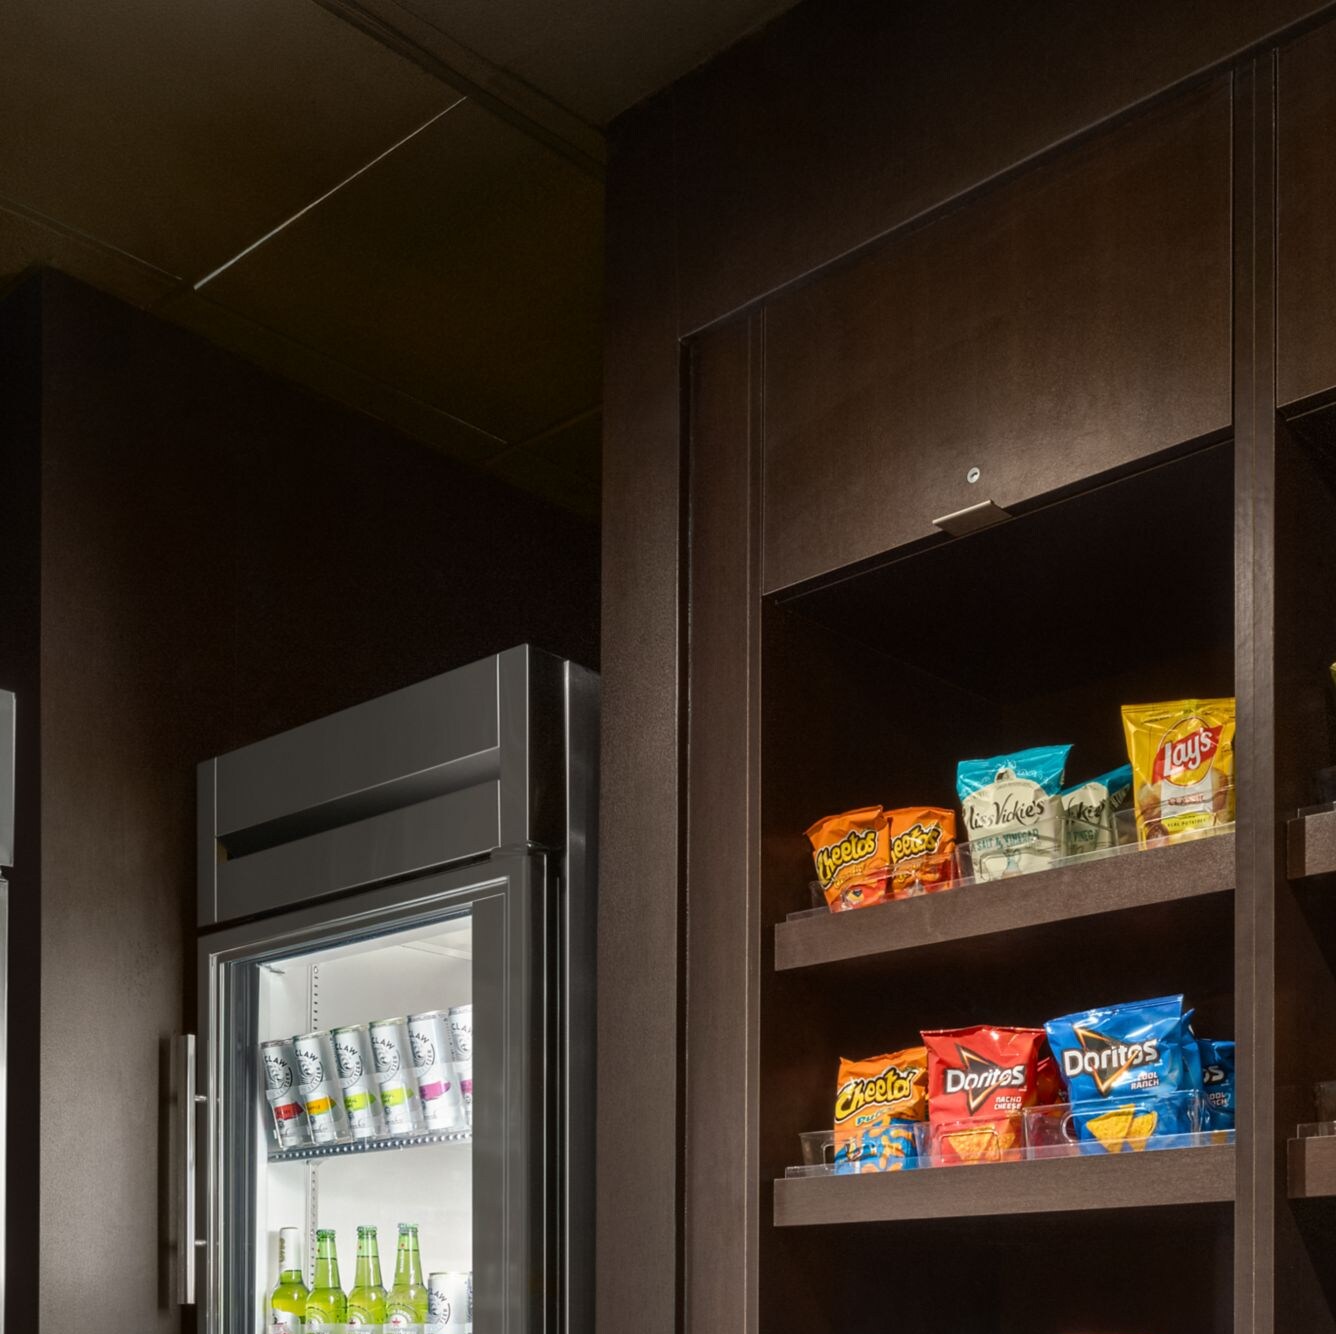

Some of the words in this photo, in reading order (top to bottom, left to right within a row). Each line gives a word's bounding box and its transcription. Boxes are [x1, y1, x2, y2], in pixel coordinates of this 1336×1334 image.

[1163, 727, 1213, 778] Lay's
[994, 792, 1046, 827] Vickie's
[891, 825, 942, 864] eetos
[976, 839, 993, 852] SALT
[1064, 1038, 1159, 1077] Doritos
[945, 1064, 1025, 1094] Doritos
[1130, 1078, 1160, 1090] RANCH
[994, 1103, 1022, 1111] CHEESE
[995, 1096, 1022, 1104] NACHO
